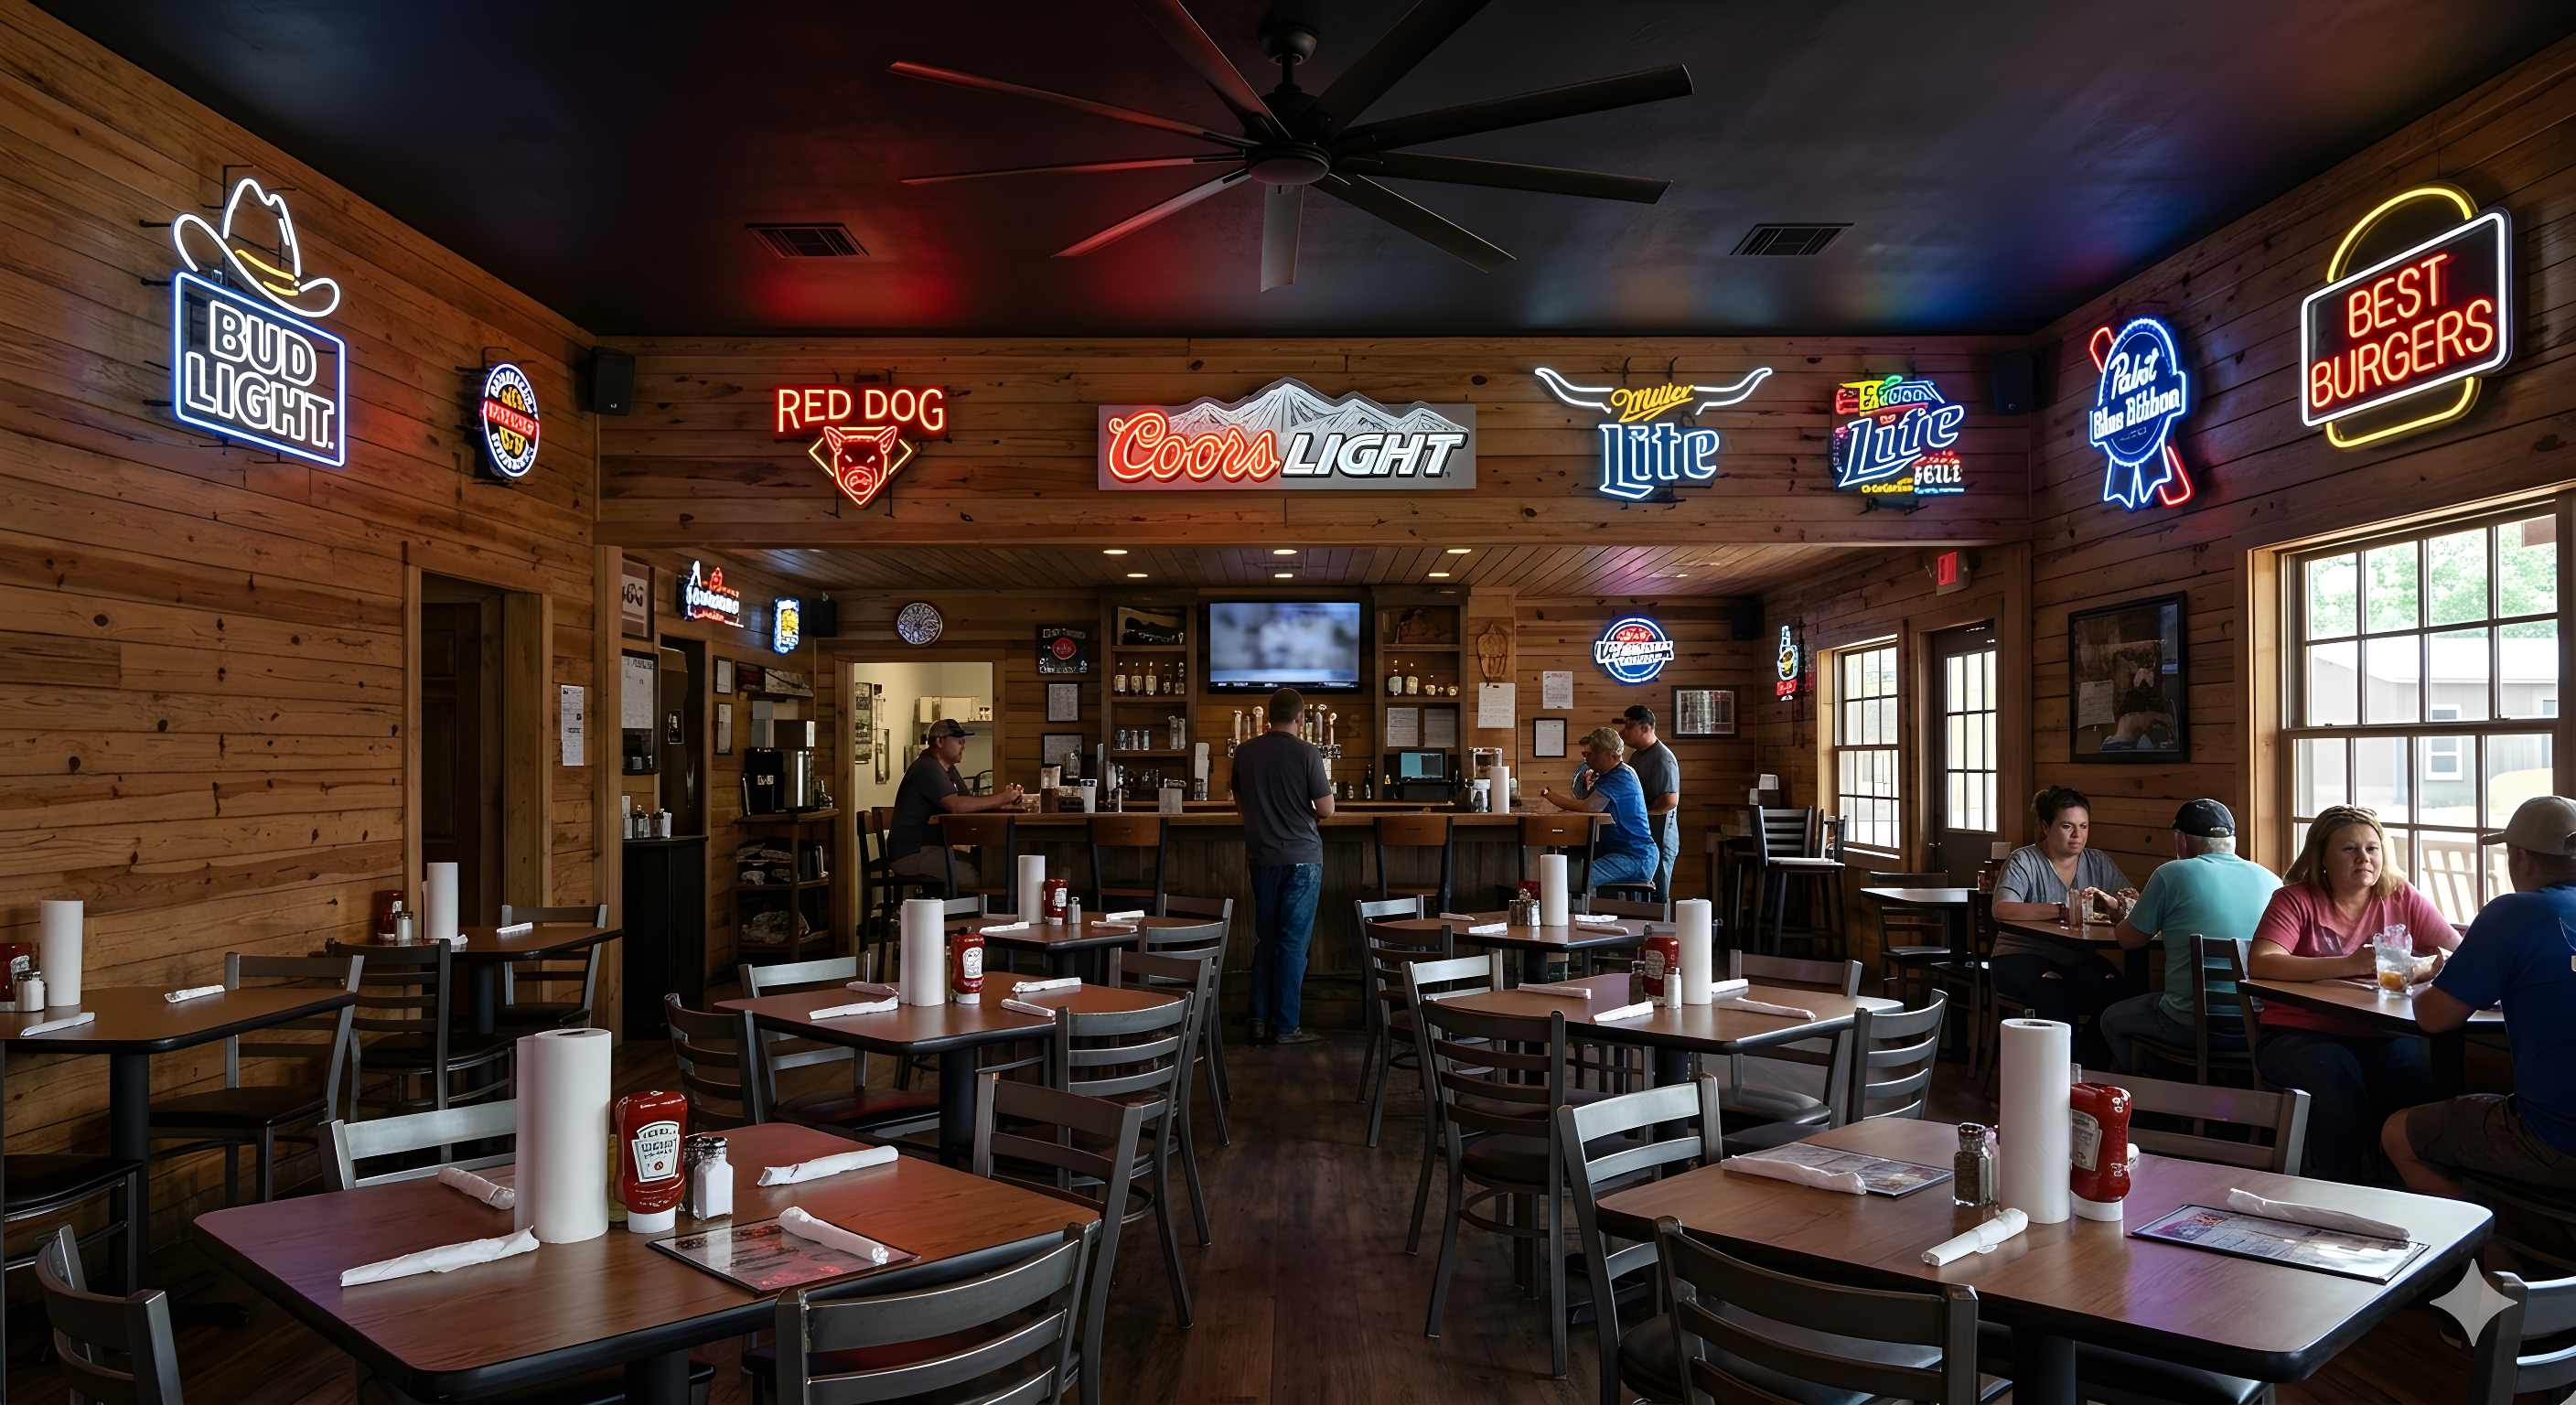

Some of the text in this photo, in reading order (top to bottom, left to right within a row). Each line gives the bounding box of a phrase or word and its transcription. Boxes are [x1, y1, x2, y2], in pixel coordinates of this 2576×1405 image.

[2348, 254, 2447, 338] BEST
[209, 300, 317, 386] BUD
[2311, 299, 2493, 408] BURGERS
[778, 389, 944, 433] RED DOG
[1106, 410, 1470, 483] Coors LIGHT
[1598, 423, 1720, 499] Lite
